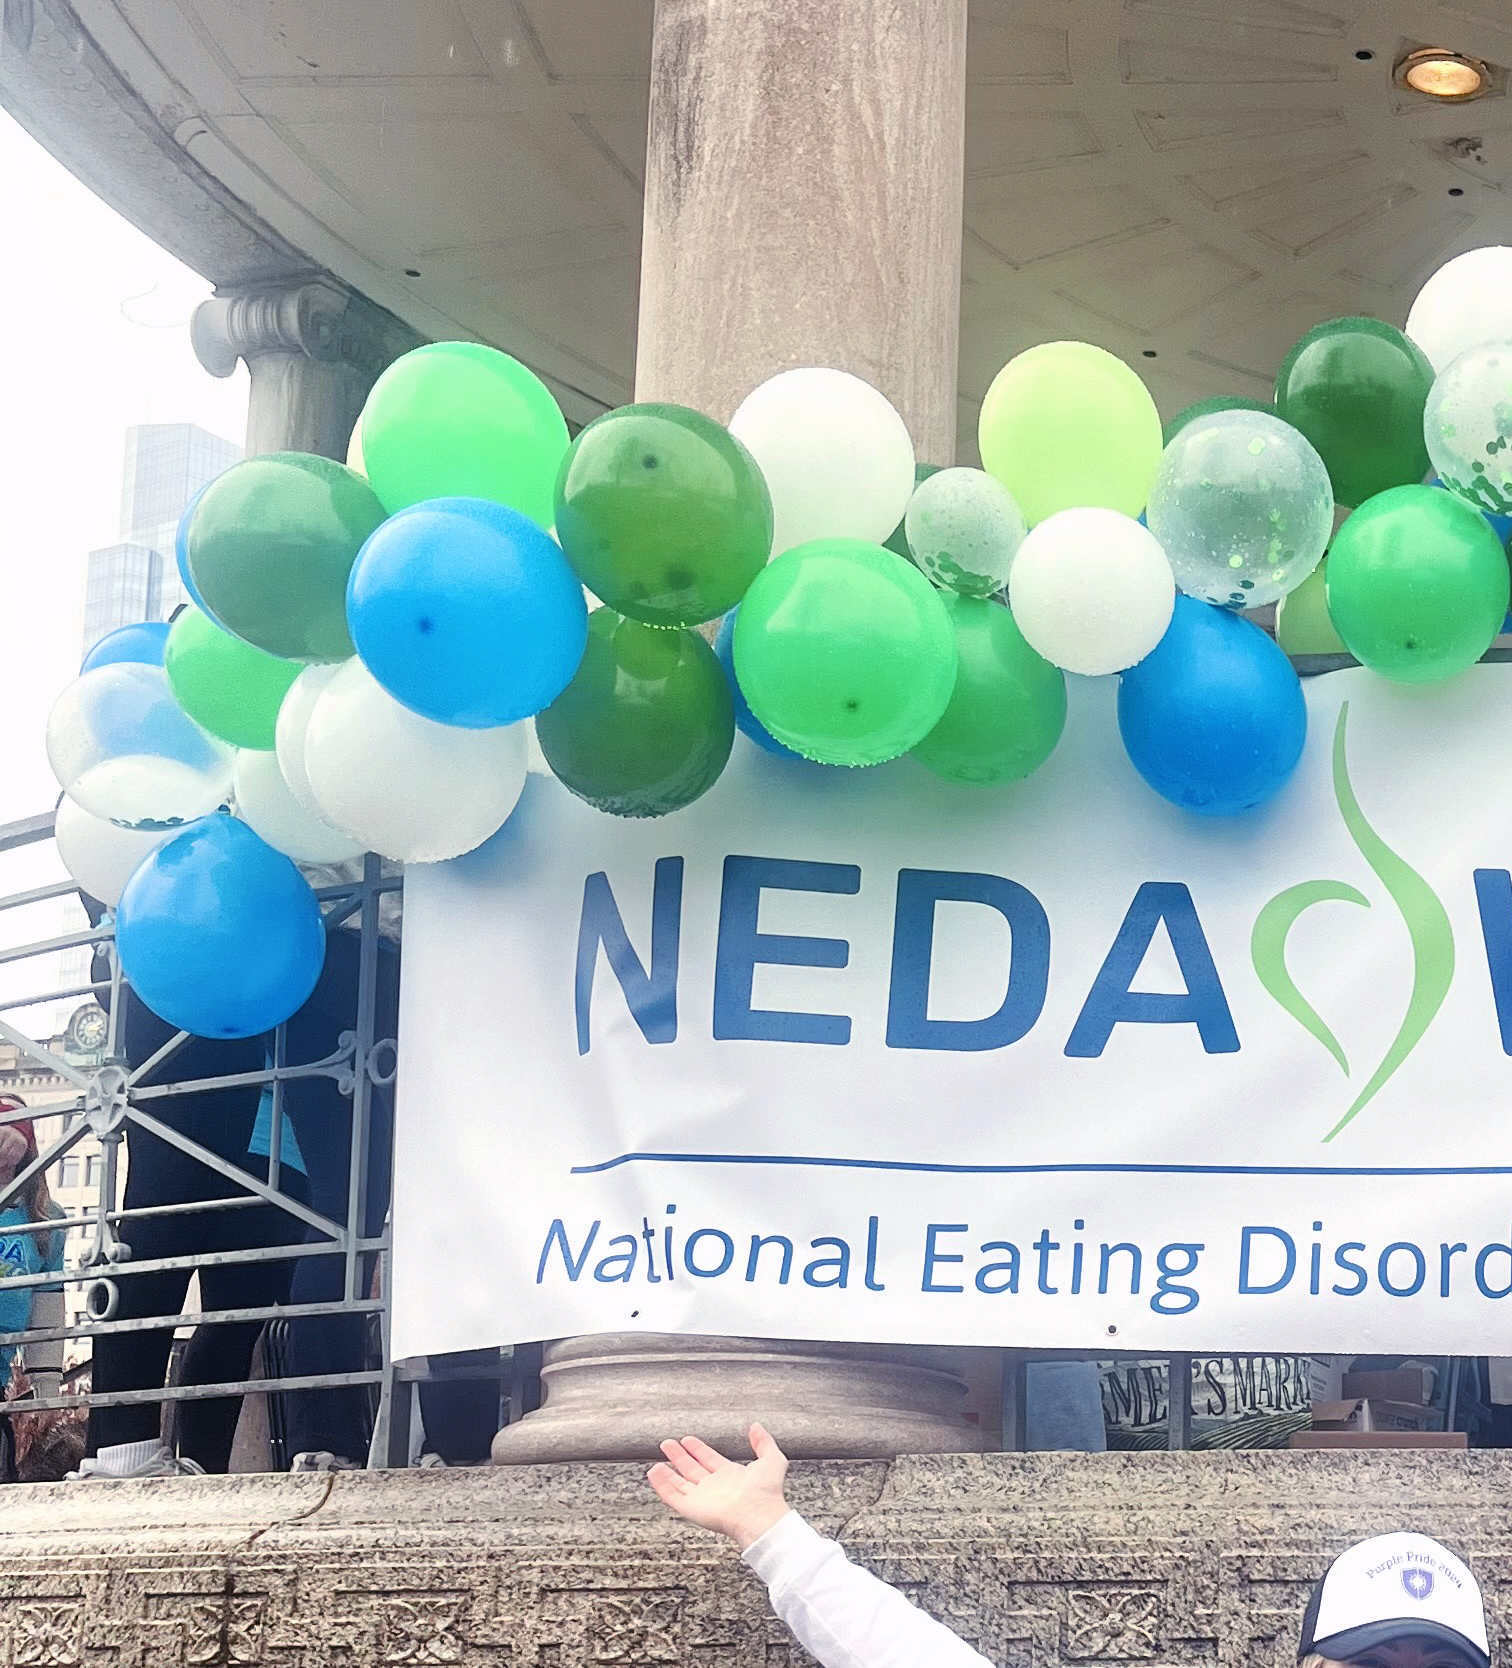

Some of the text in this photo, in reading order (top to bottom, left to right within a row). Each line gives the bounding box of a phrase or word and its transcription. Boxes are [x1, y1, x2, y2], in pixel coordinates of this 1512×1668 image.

[575, 855, 1242, 1060] NEDA
[536, 1204, 886, 1293] National
[921, 1219, 1206, 1316] Eating
[1366, 1555, 1403, 1579] Purple
[1406, 1552, 1437, 1567] Pride
